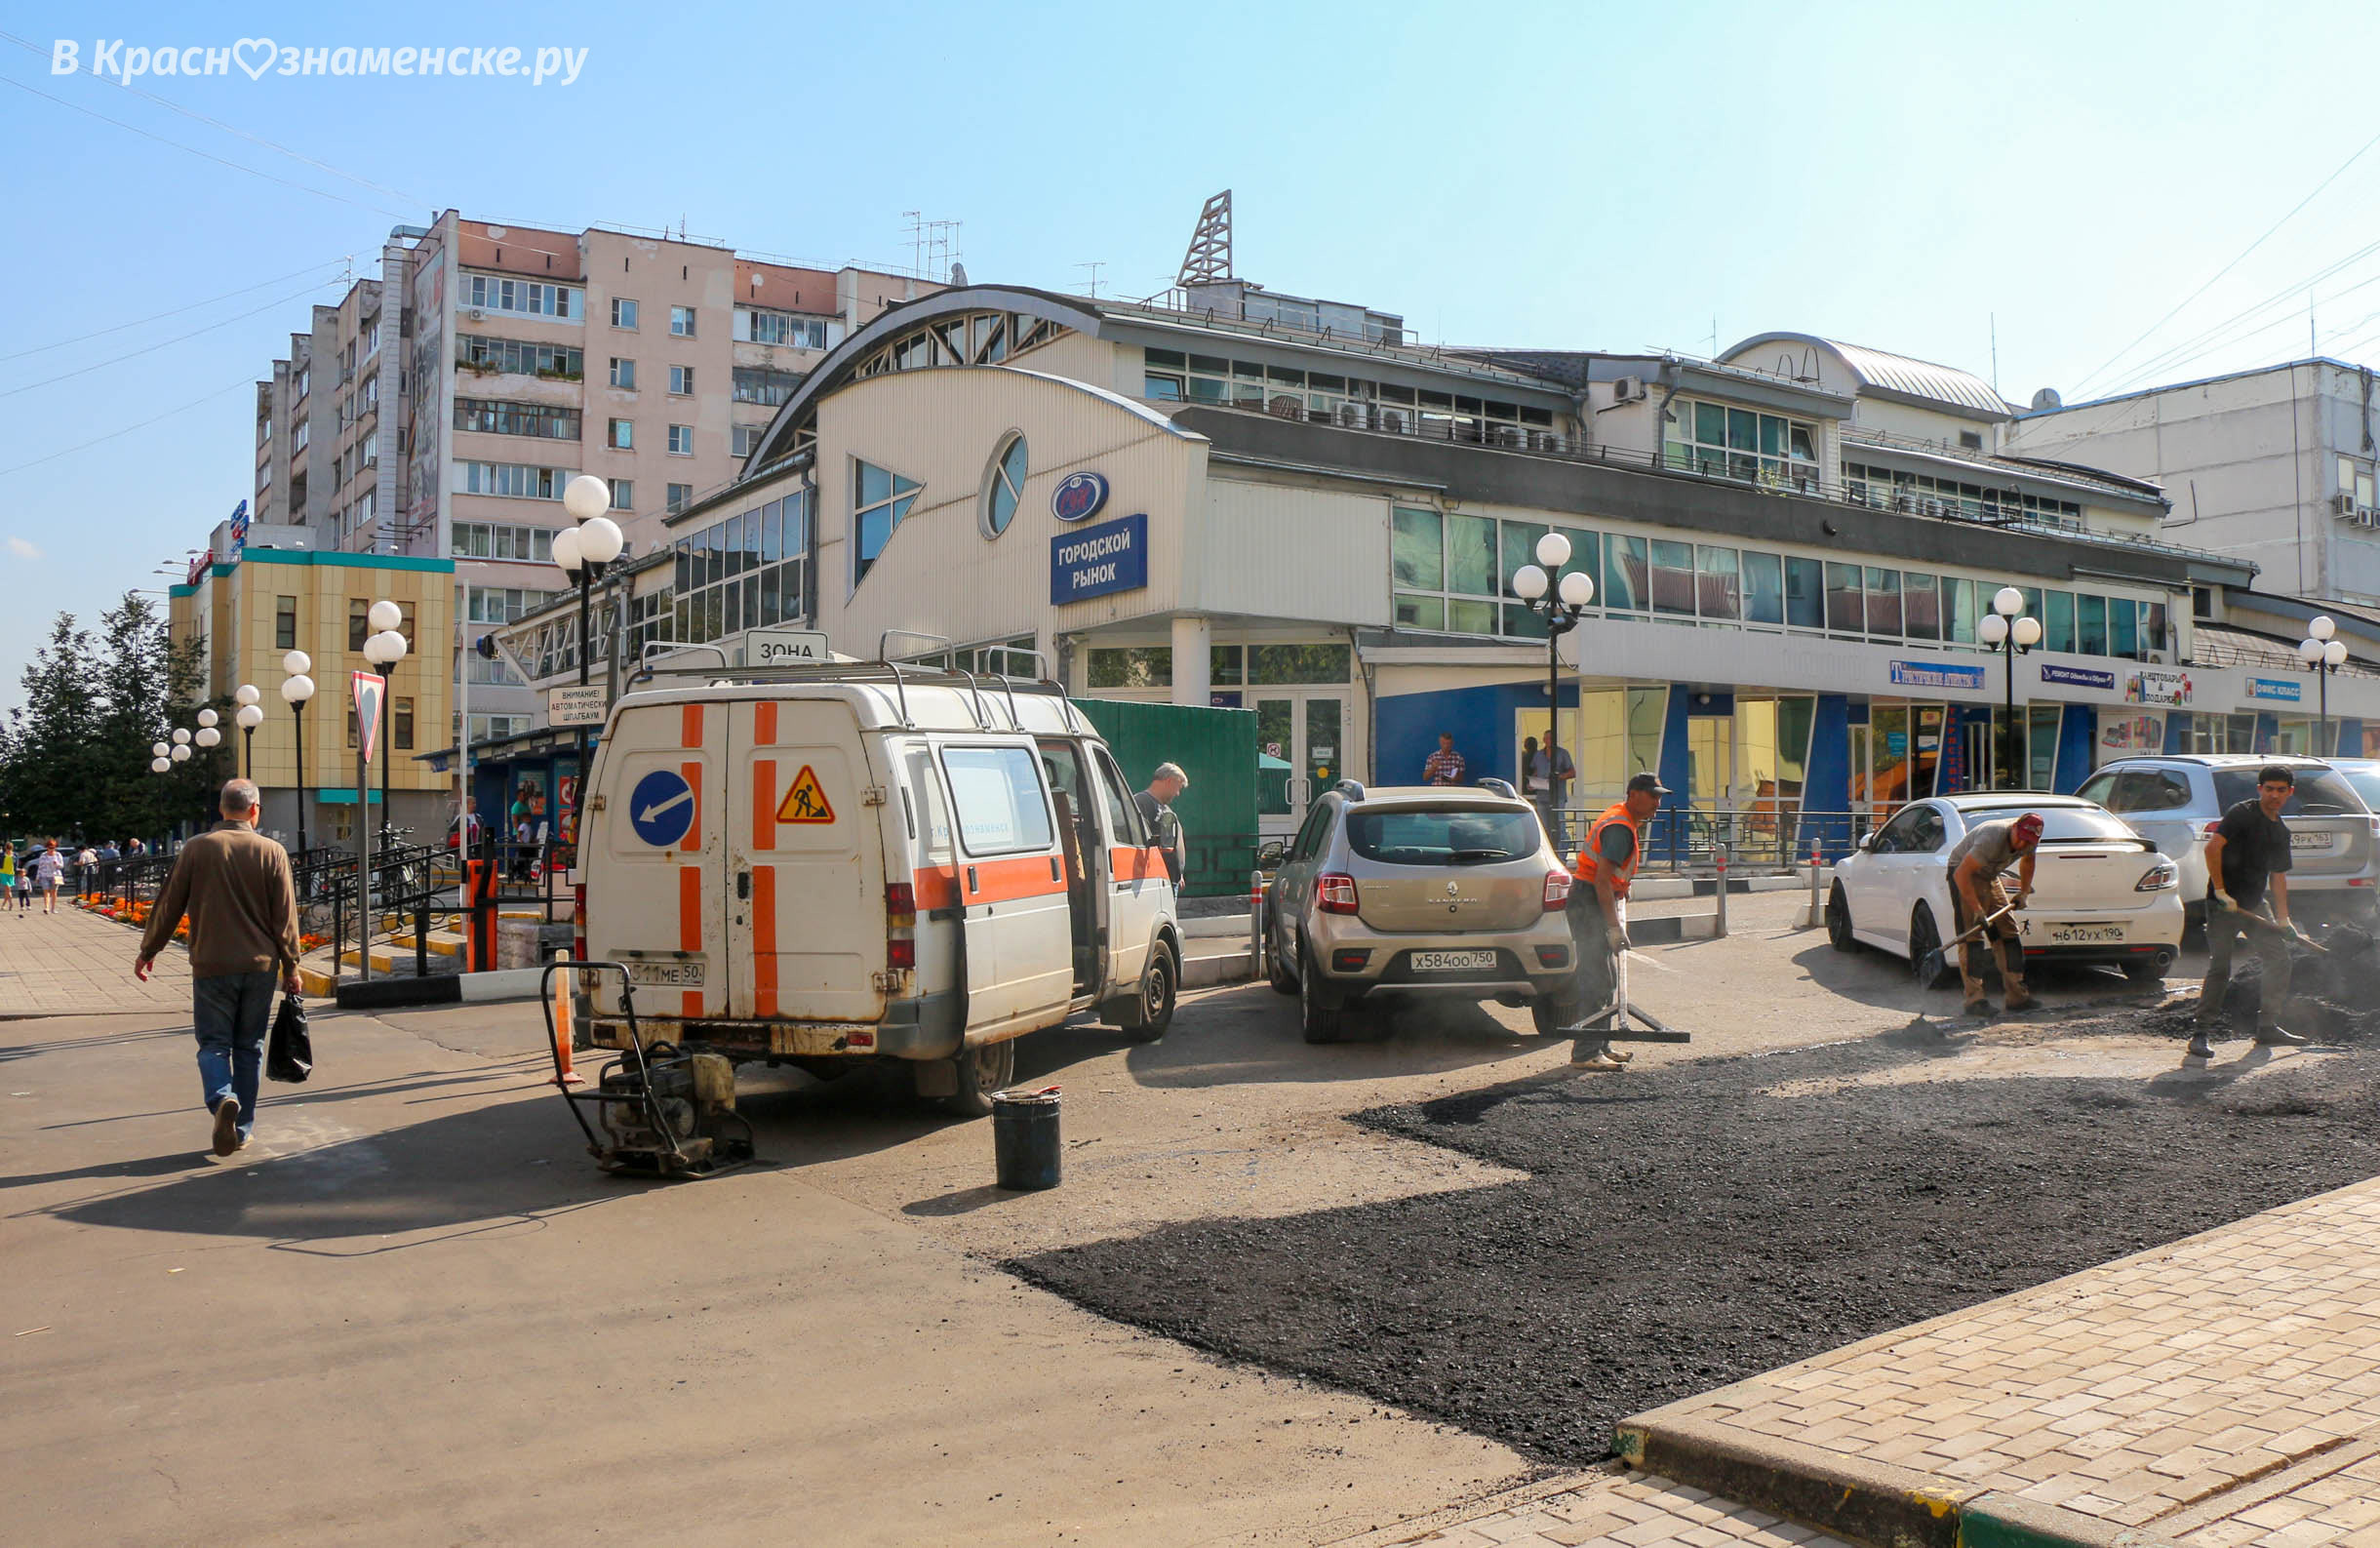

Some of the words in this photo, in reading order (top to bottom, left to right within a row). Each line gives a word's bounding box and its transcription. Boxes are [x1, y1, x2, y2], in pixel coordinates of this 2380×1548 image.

[1058, 528, 1130, 566] ГОРОДСКОЙ
[1073, 563, 1116, 589] РЫНОК
[761, 643, 813, 658] ЗОНА
[562, 690, 600, 699] ВНИМАНИЕ!
[1473, 952, 1492, 963] 750
[684, 965, 698, 977] 50
